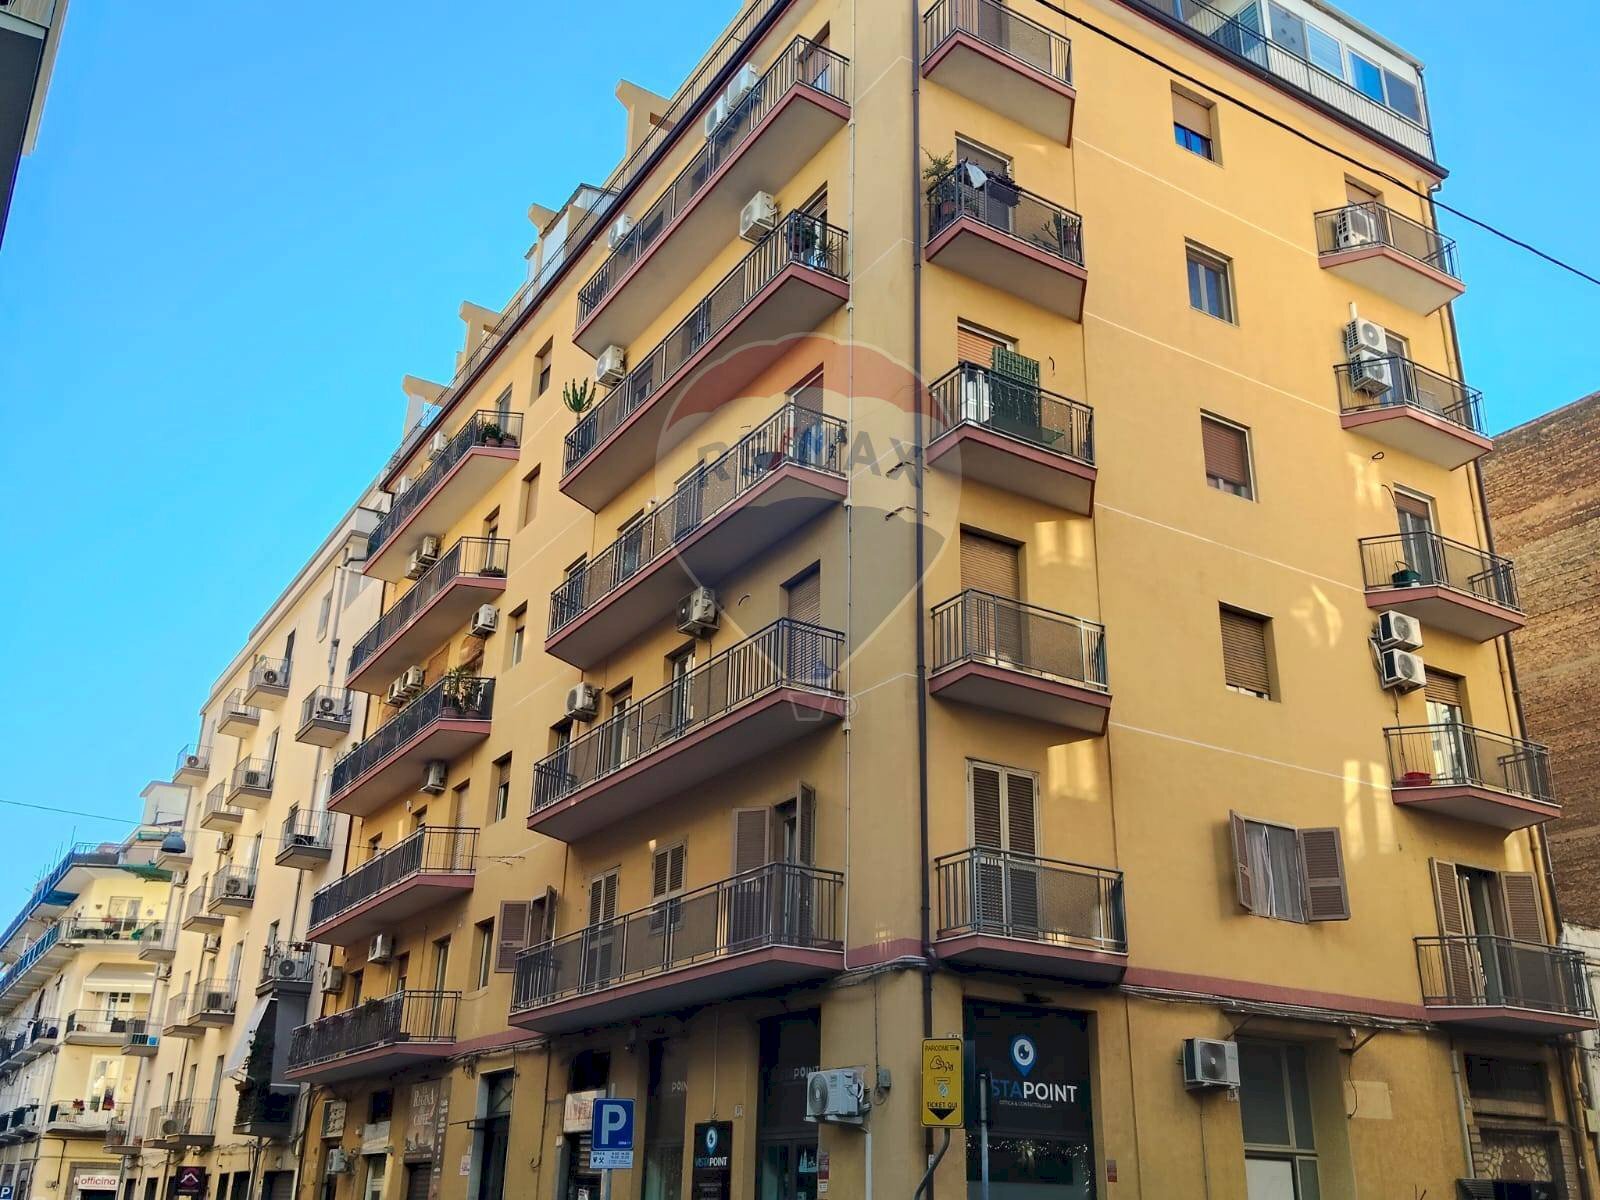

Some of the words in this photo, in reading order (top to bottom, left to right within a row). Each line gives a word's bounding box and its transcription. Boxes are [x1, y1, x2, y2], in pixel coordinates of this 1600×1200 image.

[671, 1079, 689, 1093] POIN
[991, 1080, 1078, 1103] STAPOINT
[601, 1104, 627, 1145] P
[80, 1176, 116, 1185] officina
[0, 1187, 11, 1198] P
